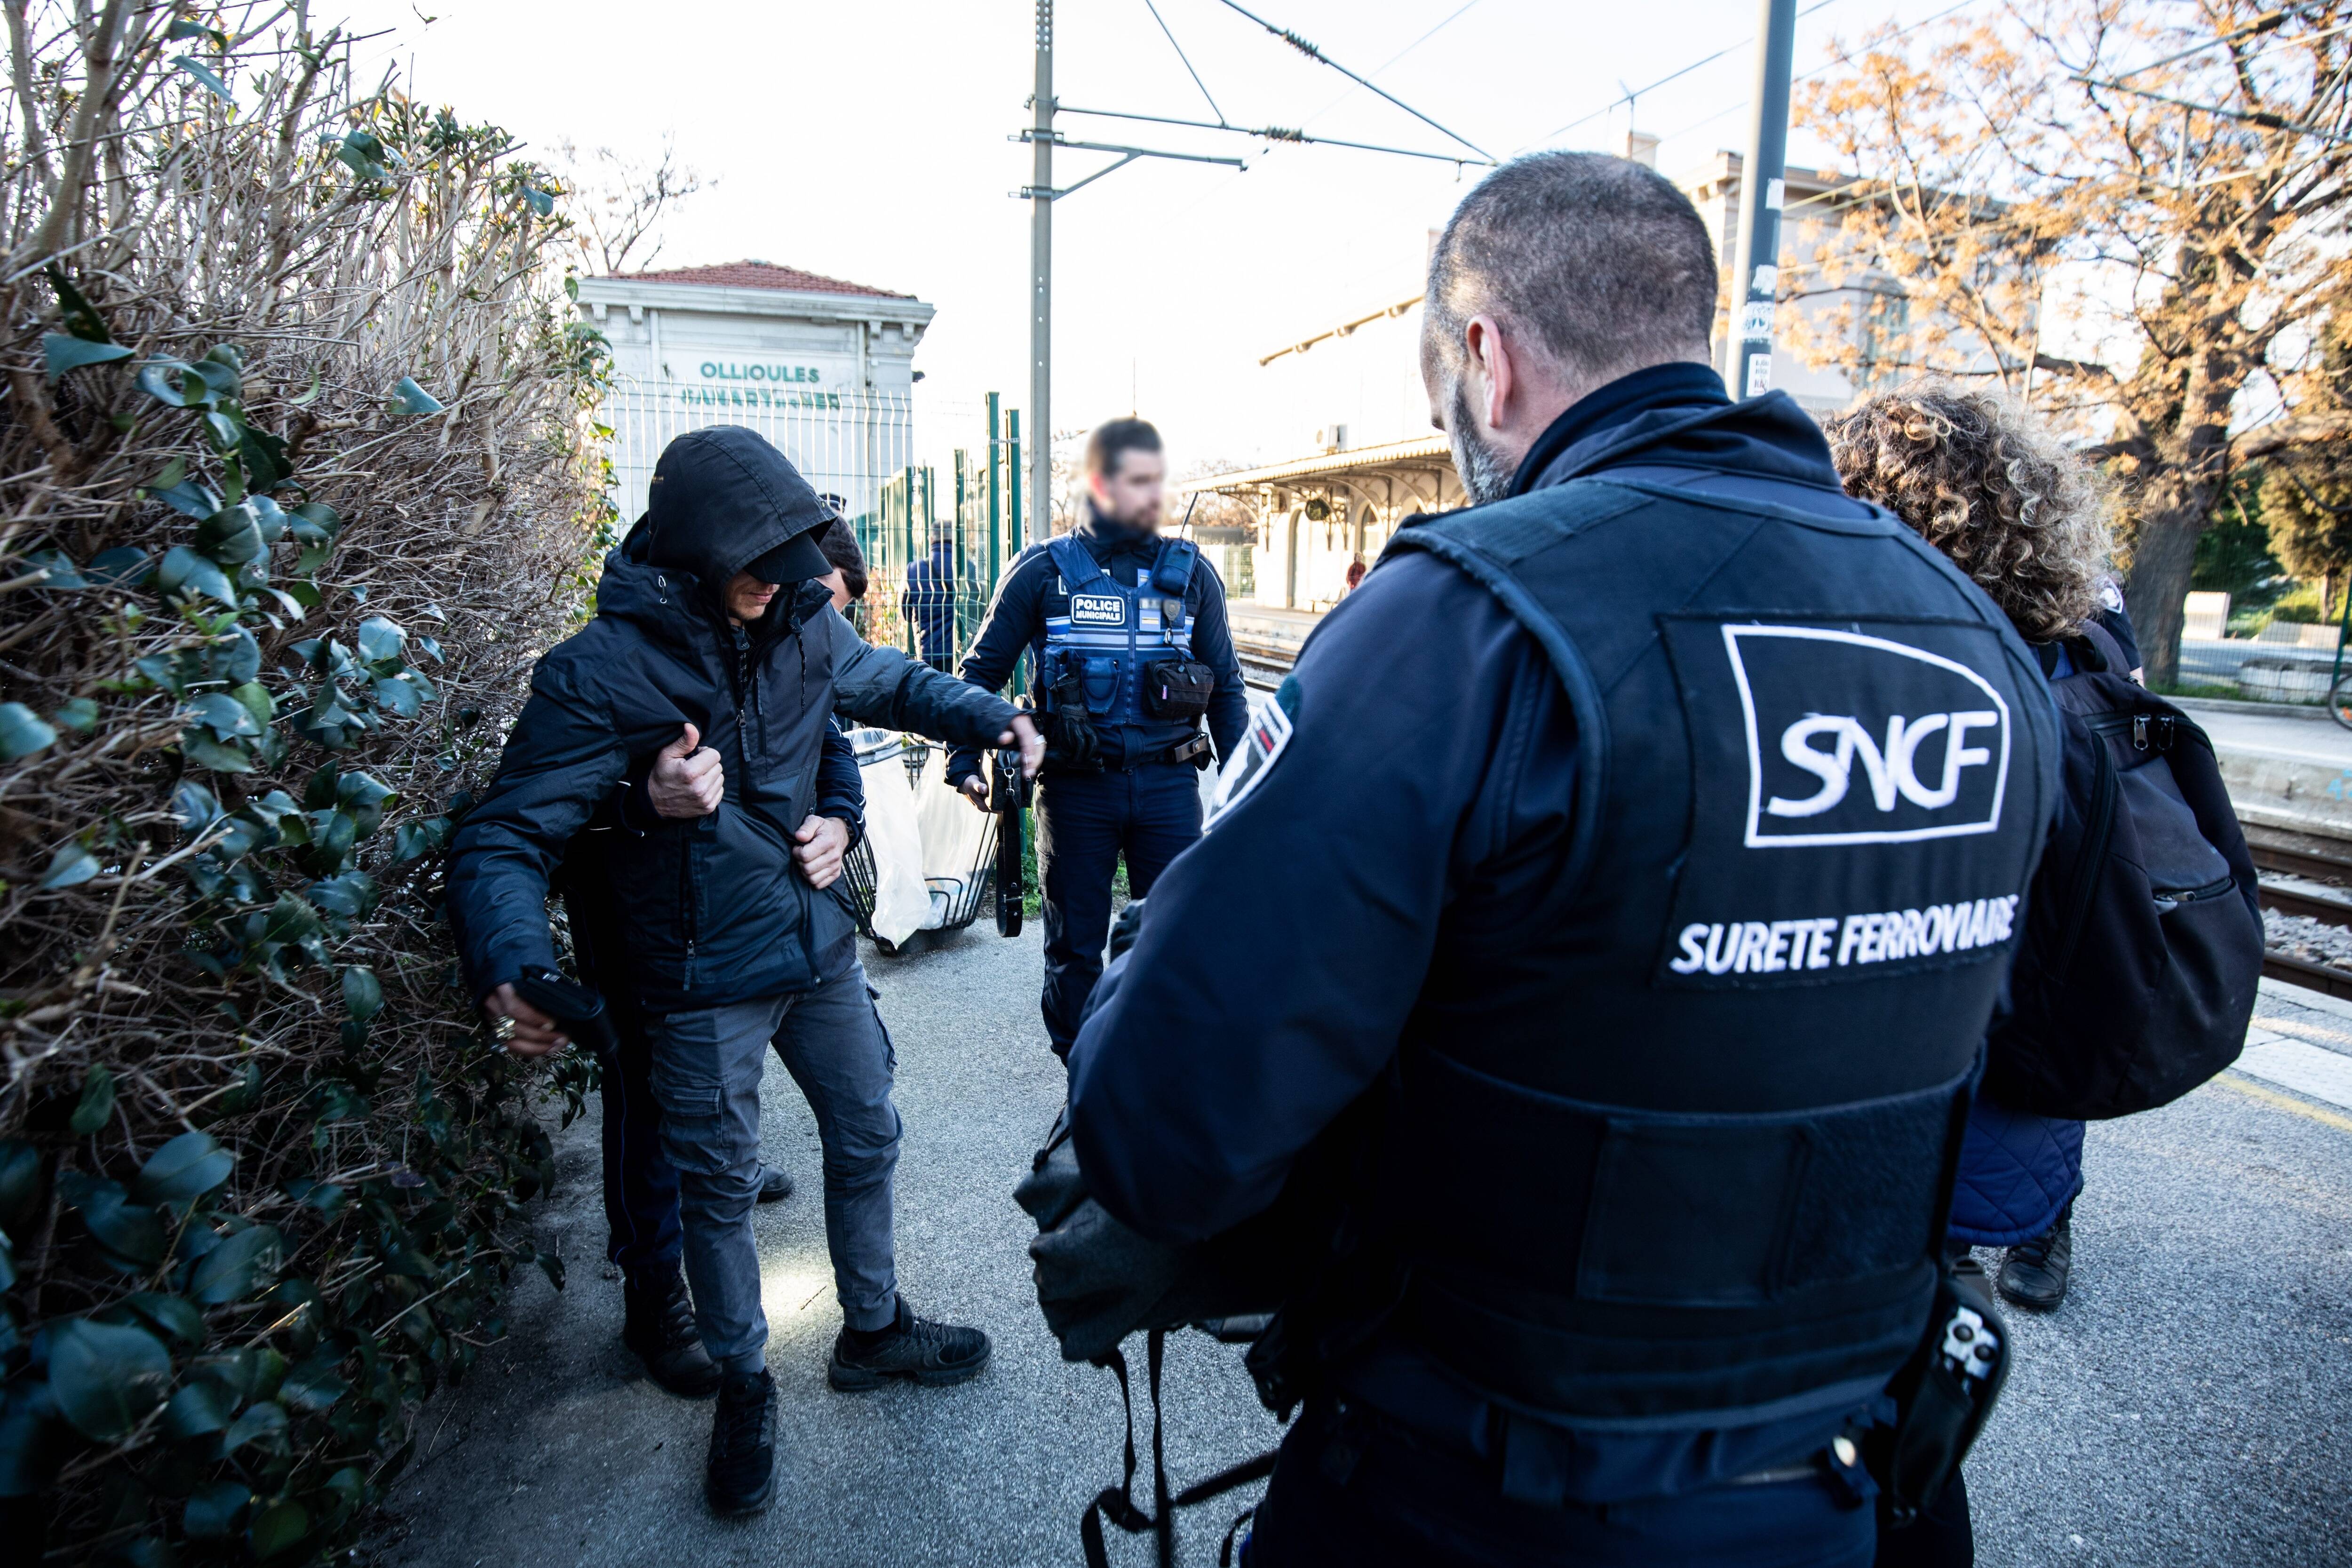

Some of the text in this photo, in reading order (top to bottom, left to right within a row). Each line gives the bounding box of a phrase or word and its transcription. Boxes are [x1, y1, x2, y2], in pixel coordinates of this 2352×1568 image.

[700, 361, 819, 383] OLLIOULES
[681, 388, 776, 408] SANARY
[1075, 610, 1120, 621] MUNICIPALE
[1076, 598, 1120, 612] POLICE
[1766, 711, 1998, 817] SNCF
[1669, 894, 2019, 976] SURETE FERROVIAIRE
